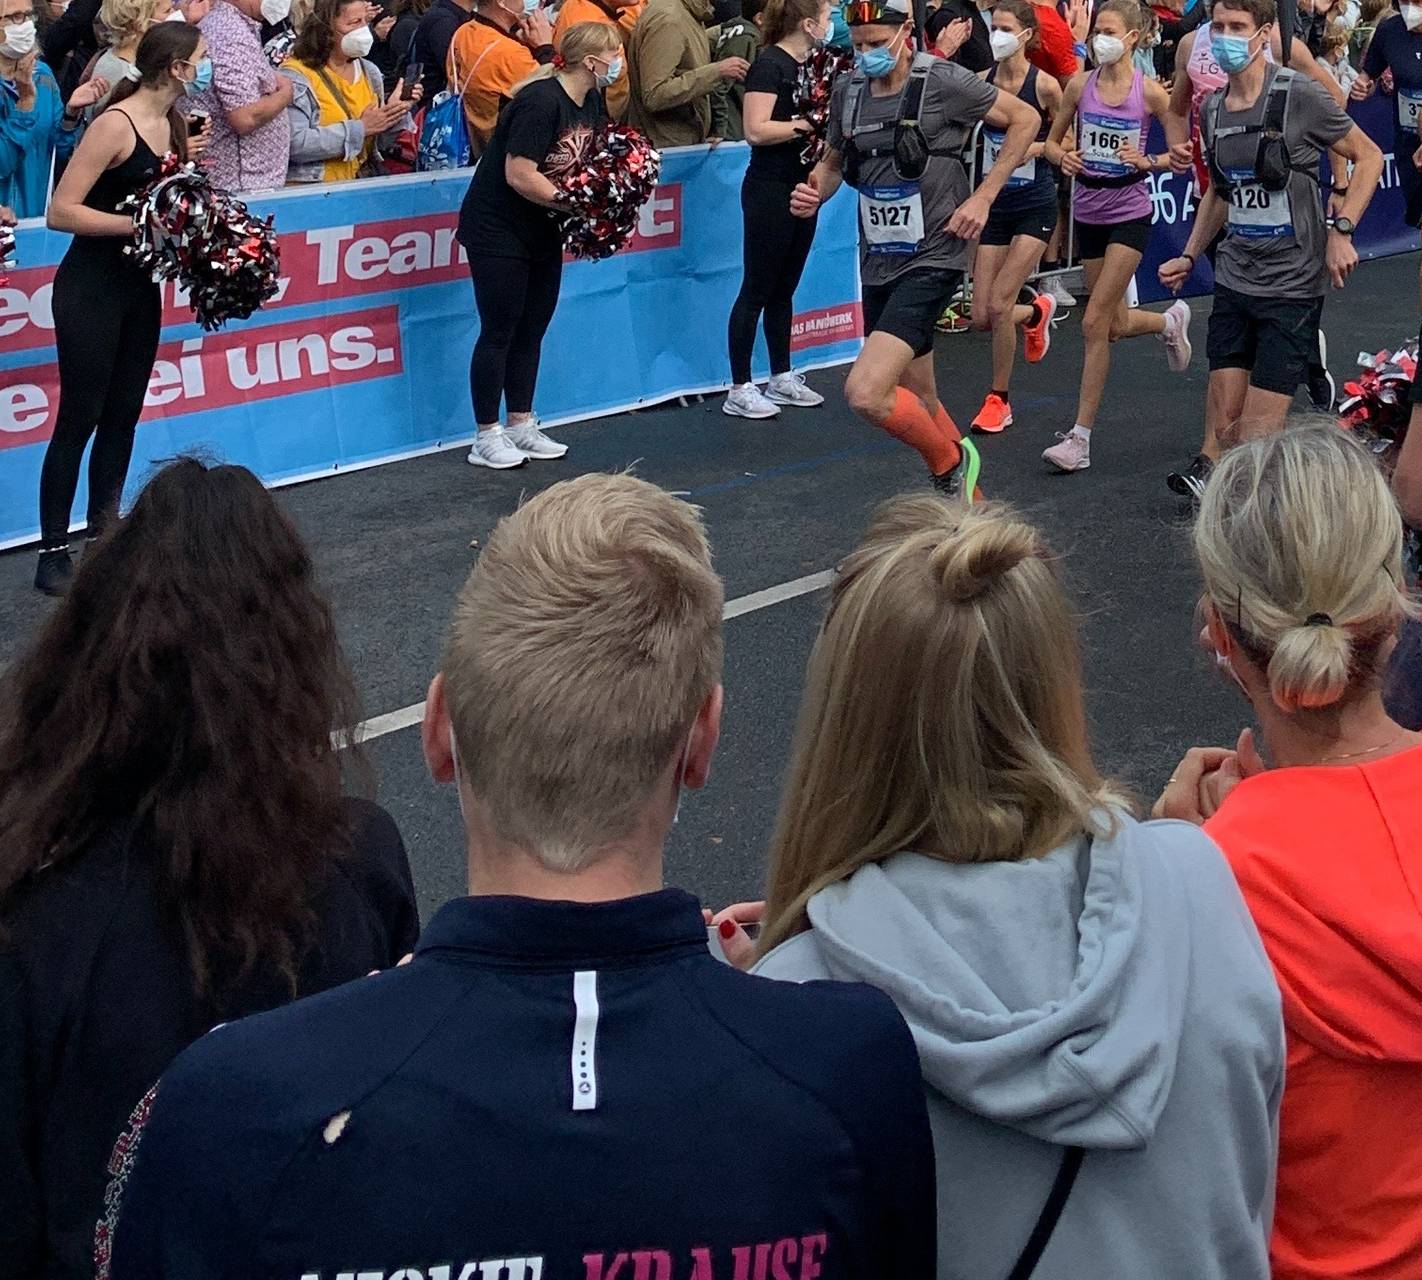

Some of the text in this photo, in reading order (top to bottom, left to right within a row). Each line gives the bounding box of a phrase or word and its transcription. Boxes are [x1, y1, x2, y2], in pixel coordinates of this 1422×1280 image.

[869, 205, 911, 227] 5127
[791, 323, 804, 336] AS
[226, 326, 394, 390] uns.
